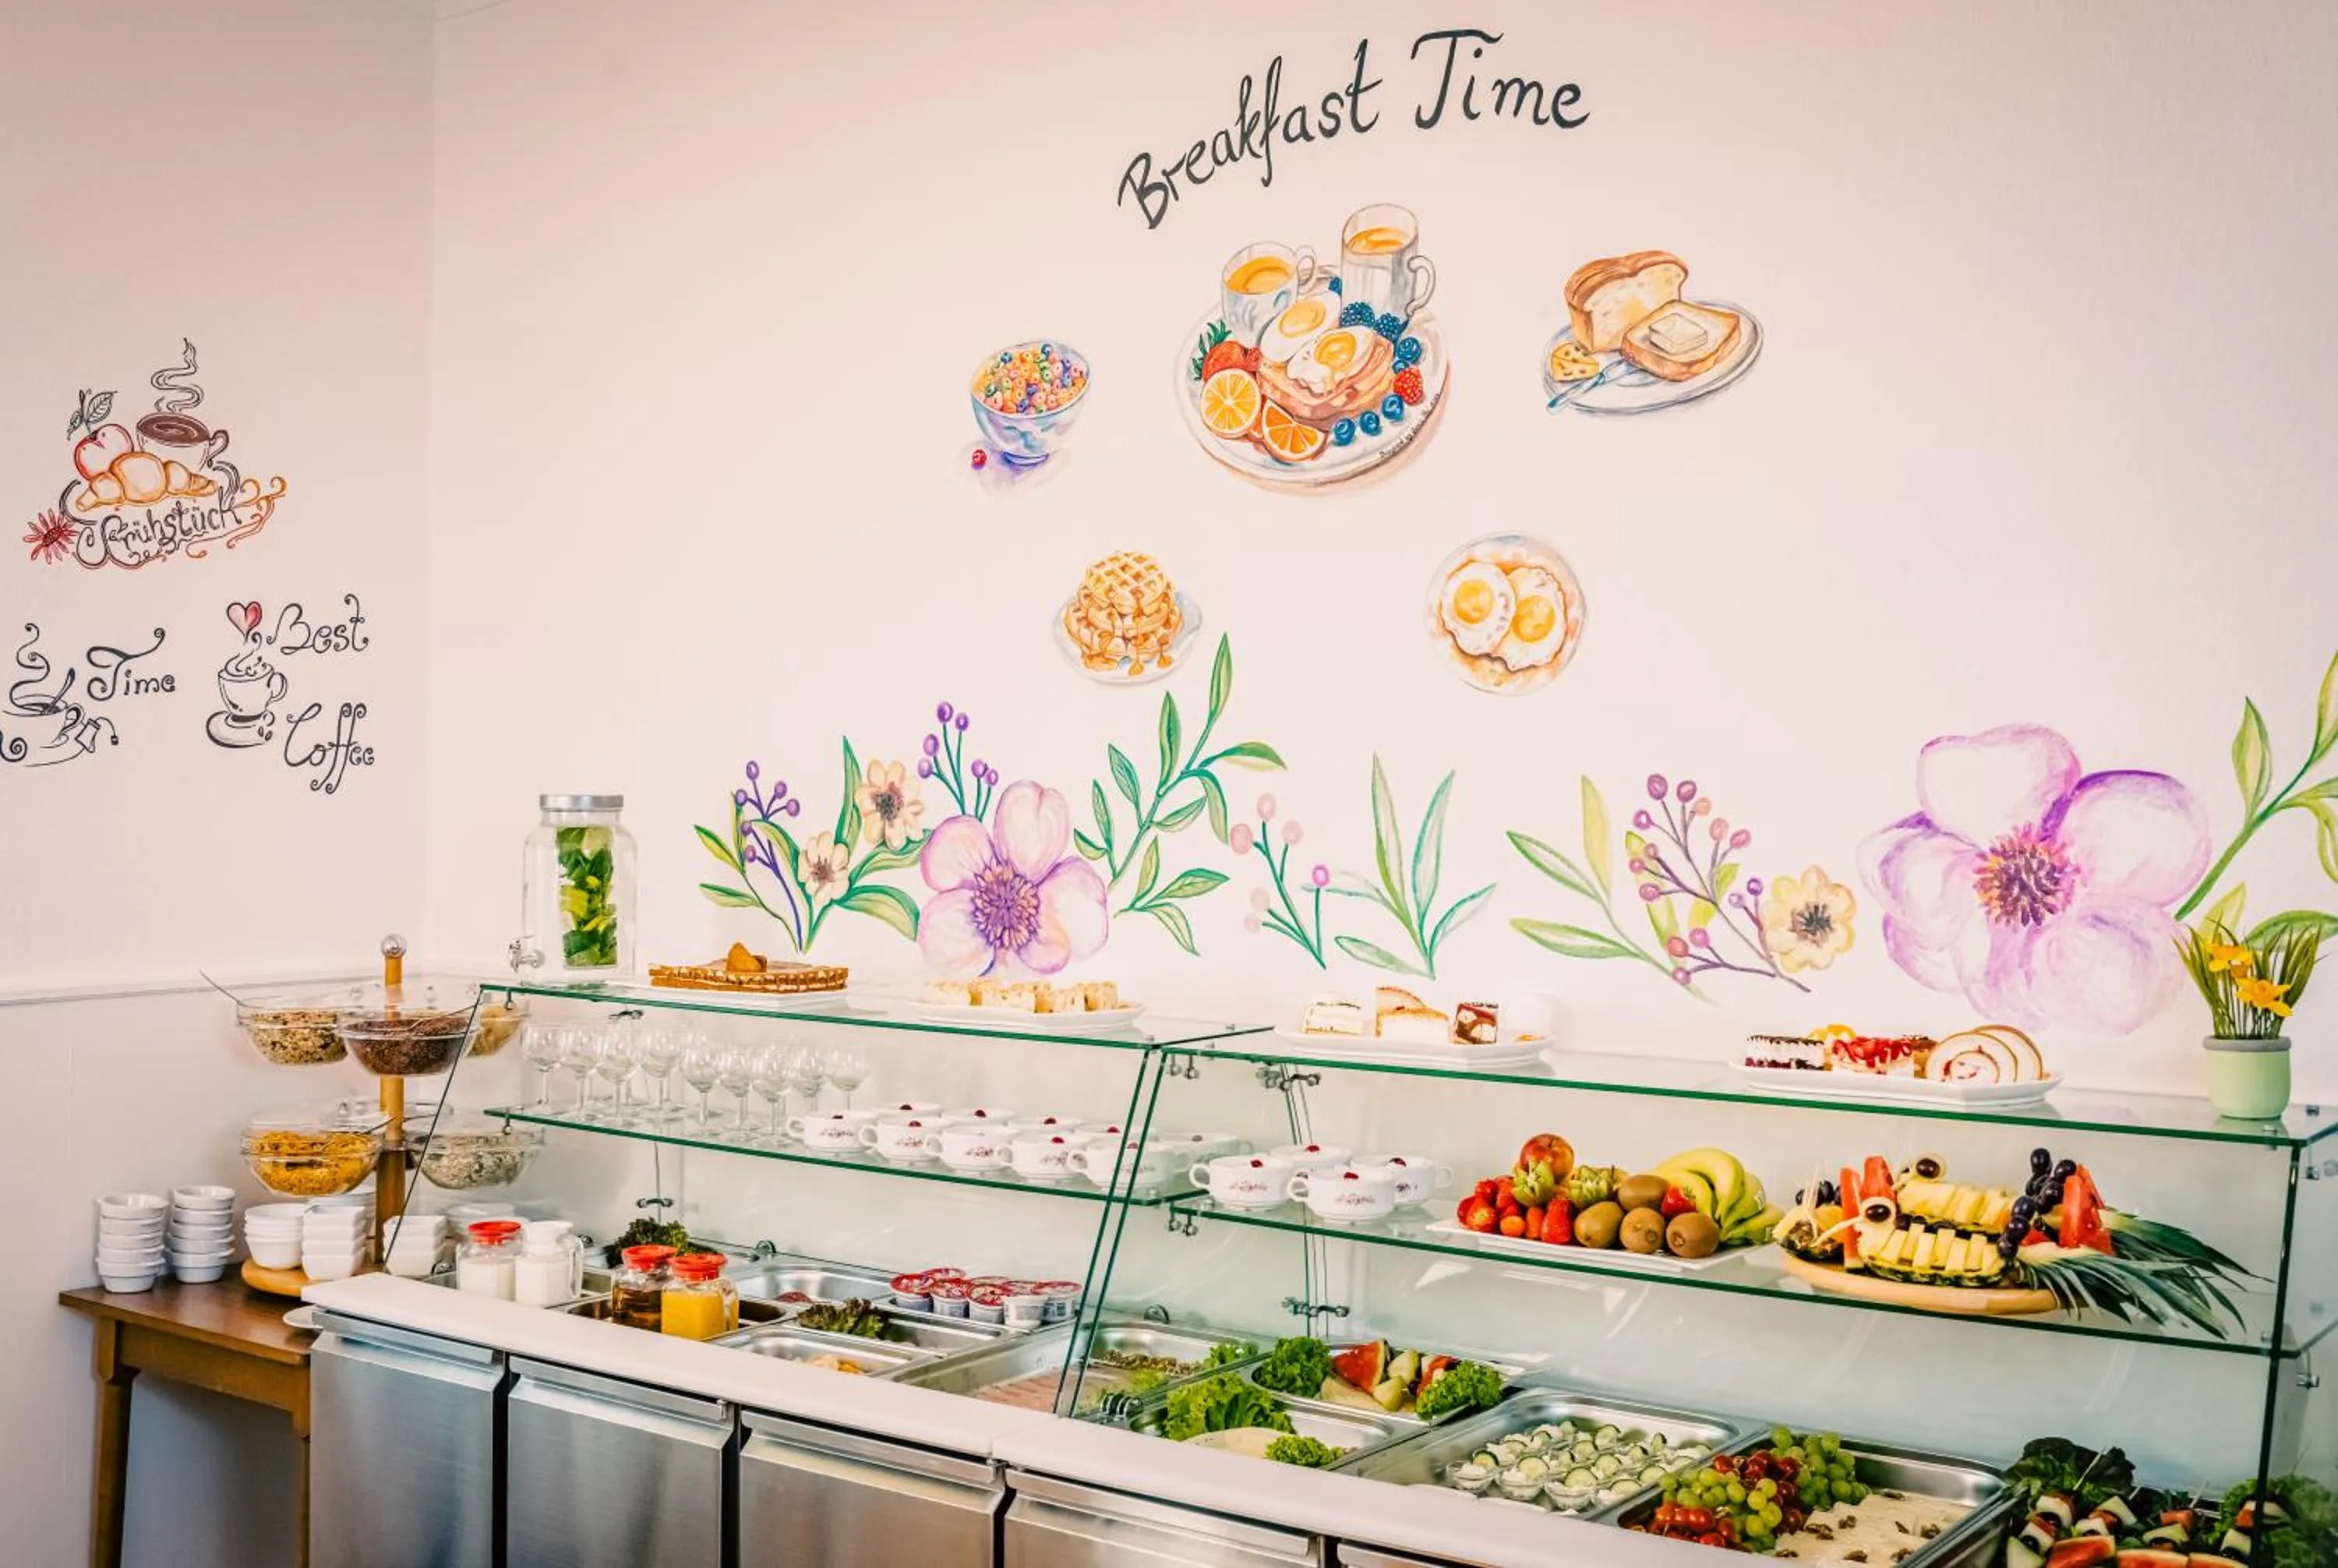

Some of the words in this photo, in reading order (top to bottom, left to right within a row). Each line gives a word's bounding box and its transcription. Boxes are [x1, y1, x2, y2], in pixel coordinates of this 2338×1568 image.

[1117, 38, 1384, 230] Breakfast
[1410, 29, 1591, 130] Time
[86, 627, 175, 701] Time
[266, 593, 369, 655] Best
[284, 702, 375, 795] Coffee
